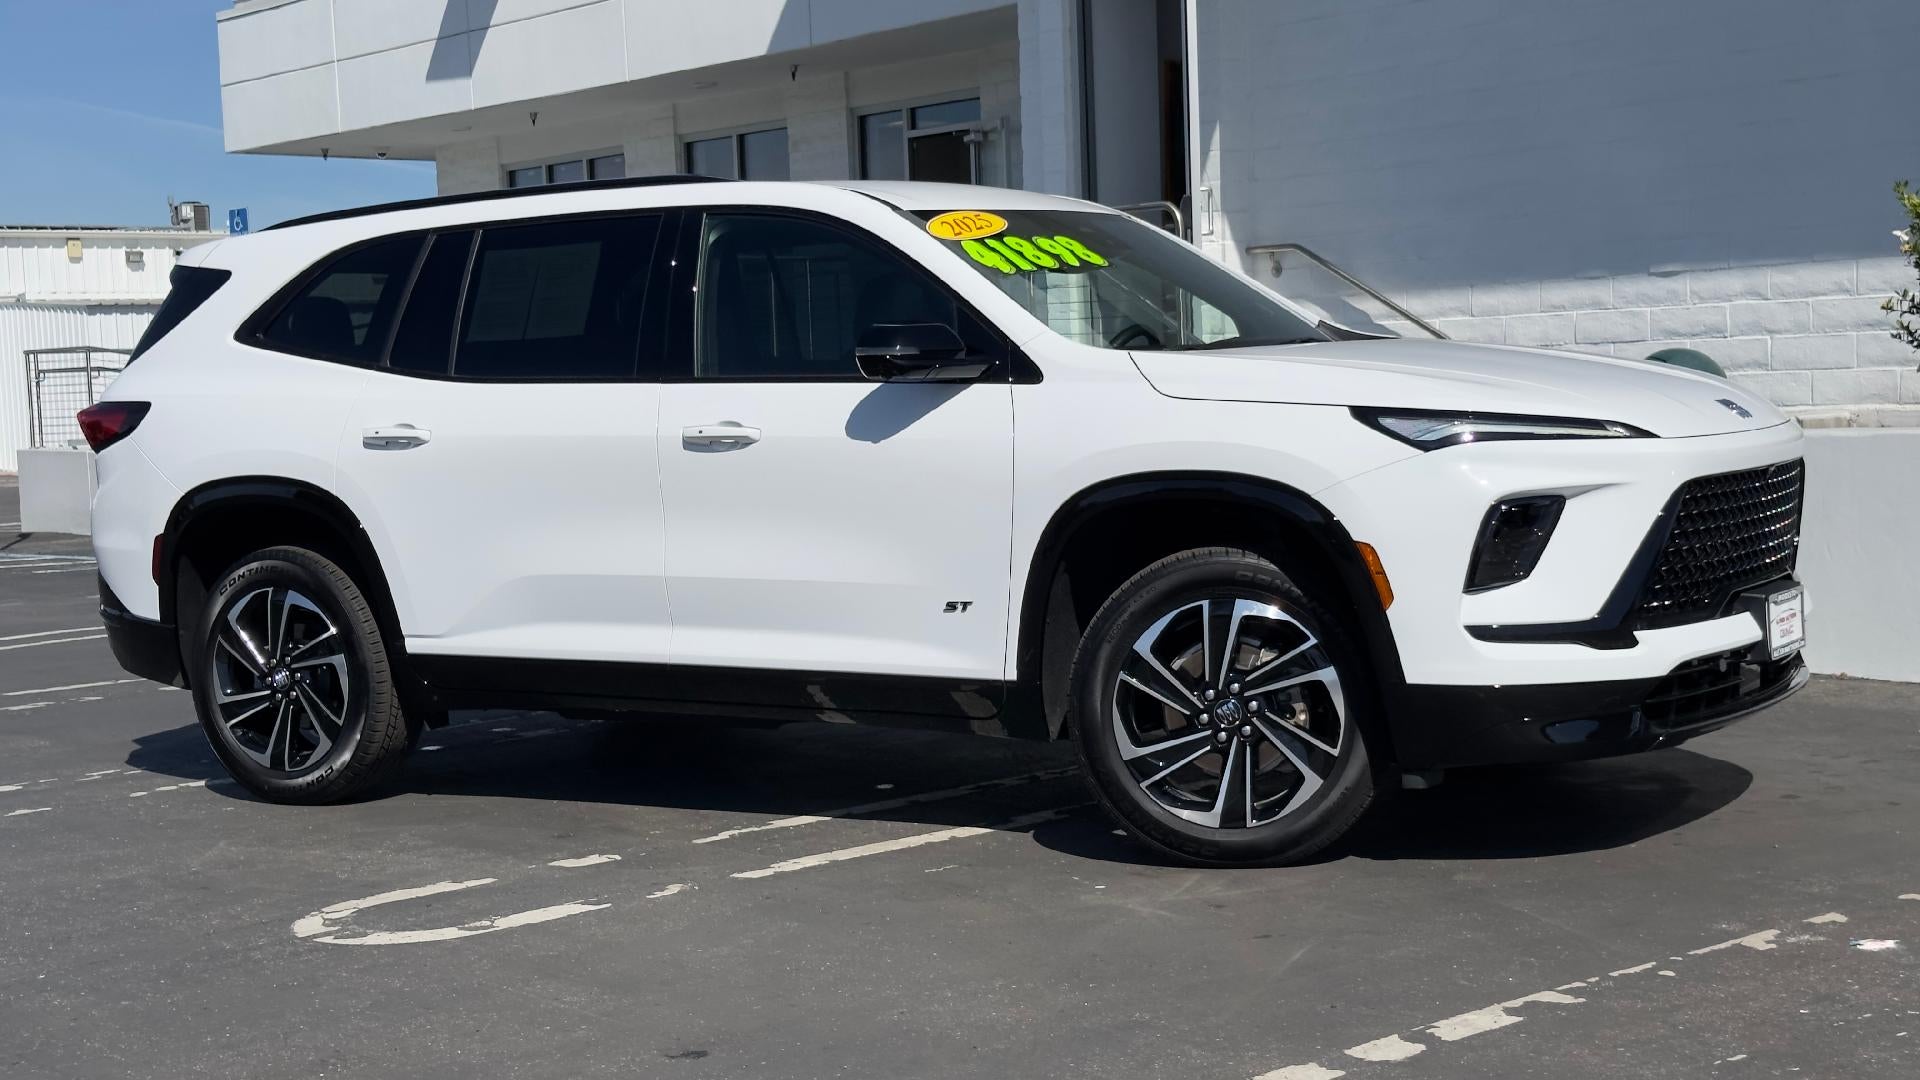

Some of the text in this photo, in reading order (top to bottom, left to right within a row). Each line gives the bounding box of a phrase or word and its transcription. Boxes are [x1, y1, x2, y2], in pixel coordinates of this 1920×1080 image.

[941, 214, 993, 236] 2025
[960, 236, 1109, 275] 41898
[943, 601, 974, 613] ST
